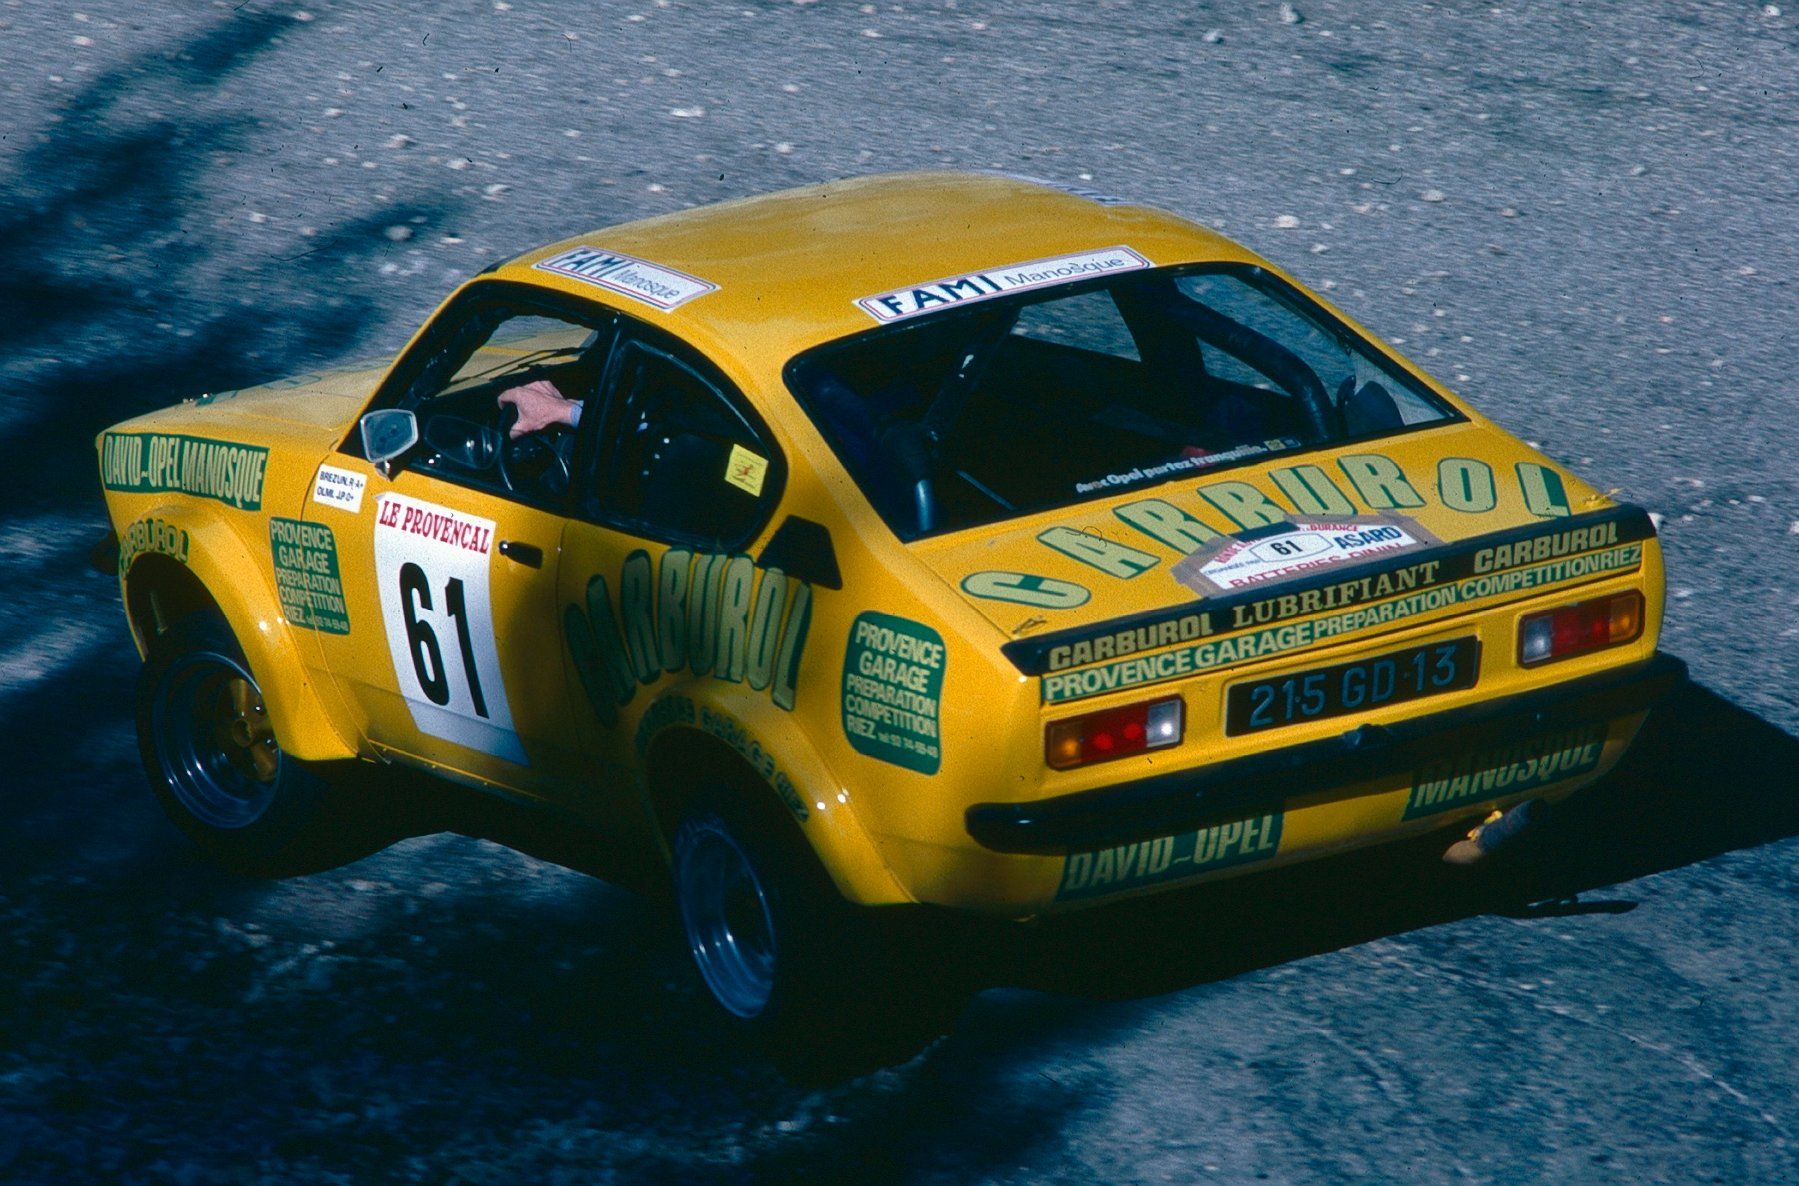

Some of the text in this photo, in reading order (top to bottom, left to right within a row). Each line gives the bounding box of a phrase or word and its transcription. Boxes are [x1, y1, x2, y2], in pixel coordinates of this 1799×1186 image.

[548, 249, 681, 299] FAMI Manosque
[876, 256, 1126, 315] FAMI Manosque
[182, 440, 267, 509] MANOSQUE
[1106, 467, 1144, 485] Opel
[270, 520, 333, 551] PROVENCE
[379, 500, 402, 528] LE
[960, 453, 1573, 611] CARBUROL
[119, 518, 190, 572] ARBUROL
[278, 545, 331, 574] GARAGE
[1270, 540, 1303, 555] 61
[1333, 526, 1403, 550] ASARD
[275, 567, 343, 596] PREPARATION
[1049, 520, 1619, 671] CARBUROL LUBRIFIANT CARBUROL
[400, 561, 490, 719] 61
[855, 620, 944, 669] PROVENCE
[1044, 544, 1642, 701] PROVENCE GARAGE PREPARATION COMPETITION RIEZ
[858, 650, 931, 693] GARAGE
[1249, 644, 1456, 728] 215 GD 13
[845, 694, 937, 738] COMPETITION
[846, 673, 937, 718] PREPARATION
[846, 714, 877, 740] RIEZ
